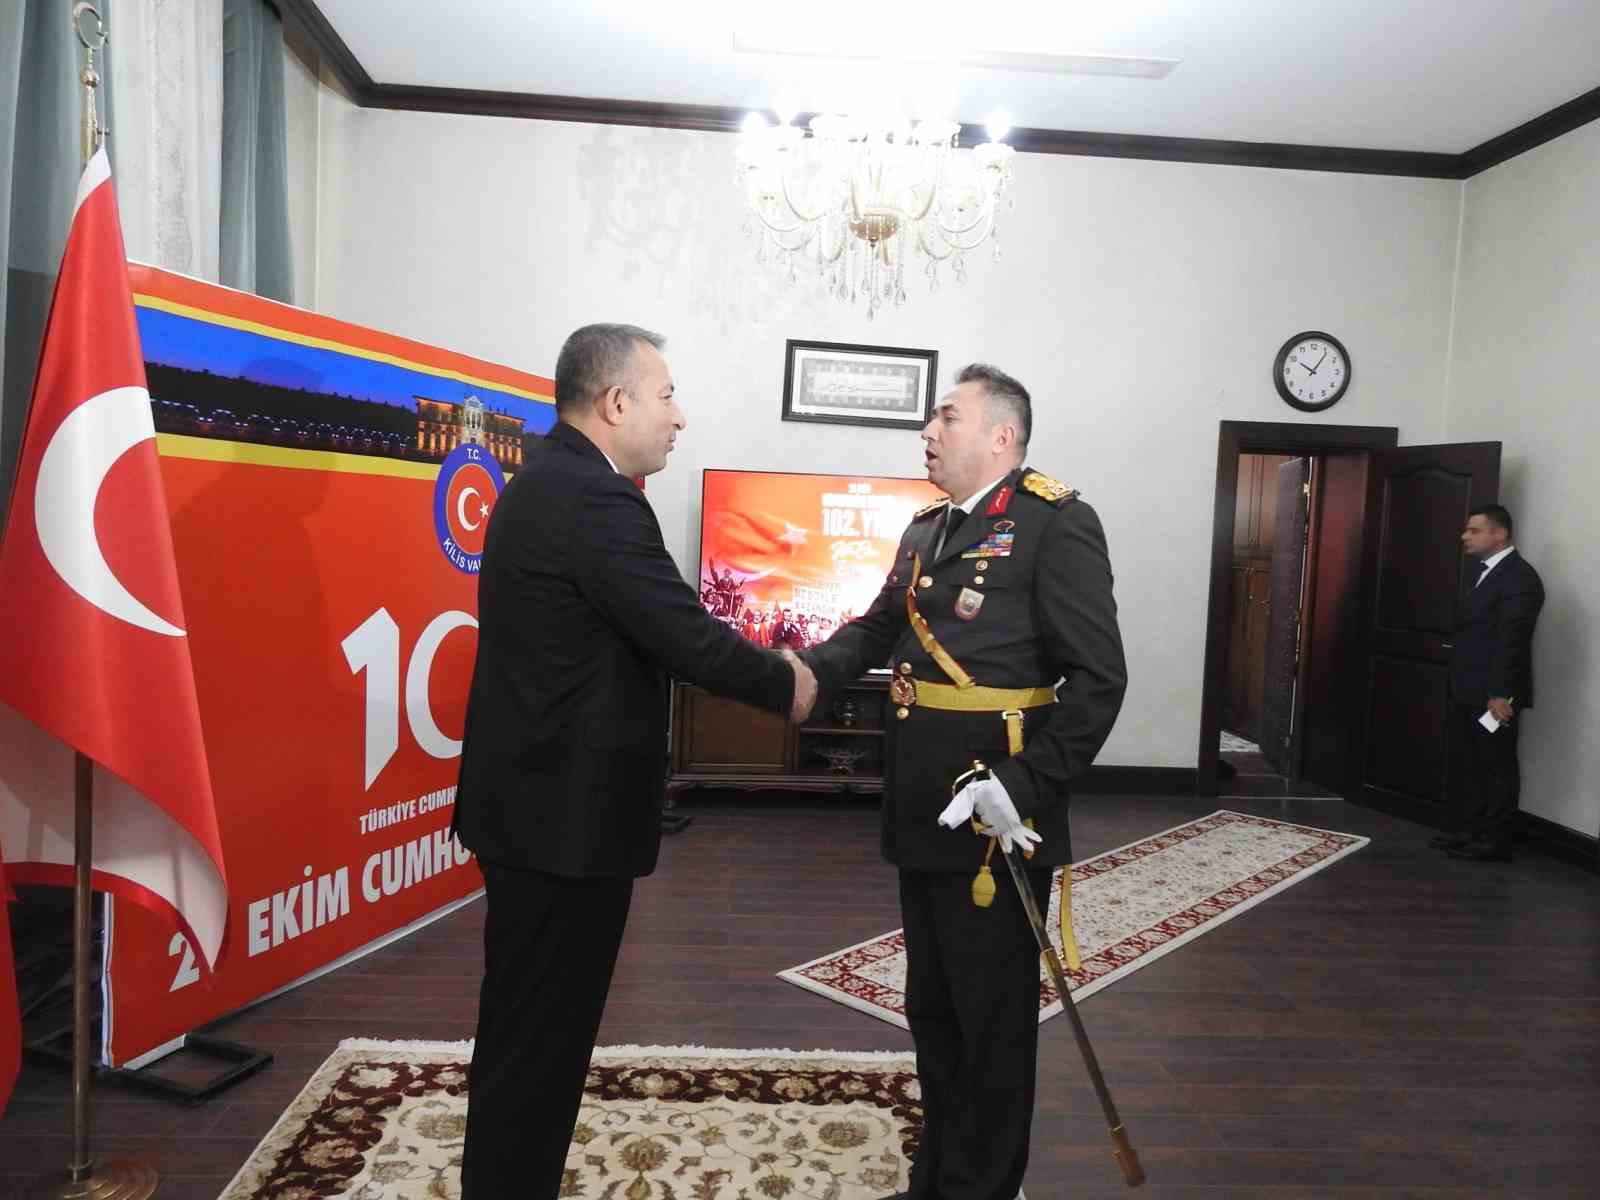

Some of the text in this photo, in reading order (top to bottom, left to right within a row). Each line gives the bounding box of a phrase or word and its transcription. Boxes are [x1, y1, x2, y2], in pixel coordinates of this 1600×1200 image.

[466, 447, 482, 461] T.C.
[443, 537, 466, 569] KİLİS
[359, 800, 417, 835] TÜRKİYE
[248, 865, 350, 957] EKİM
[362, 826, 476, 904] CUMHU
